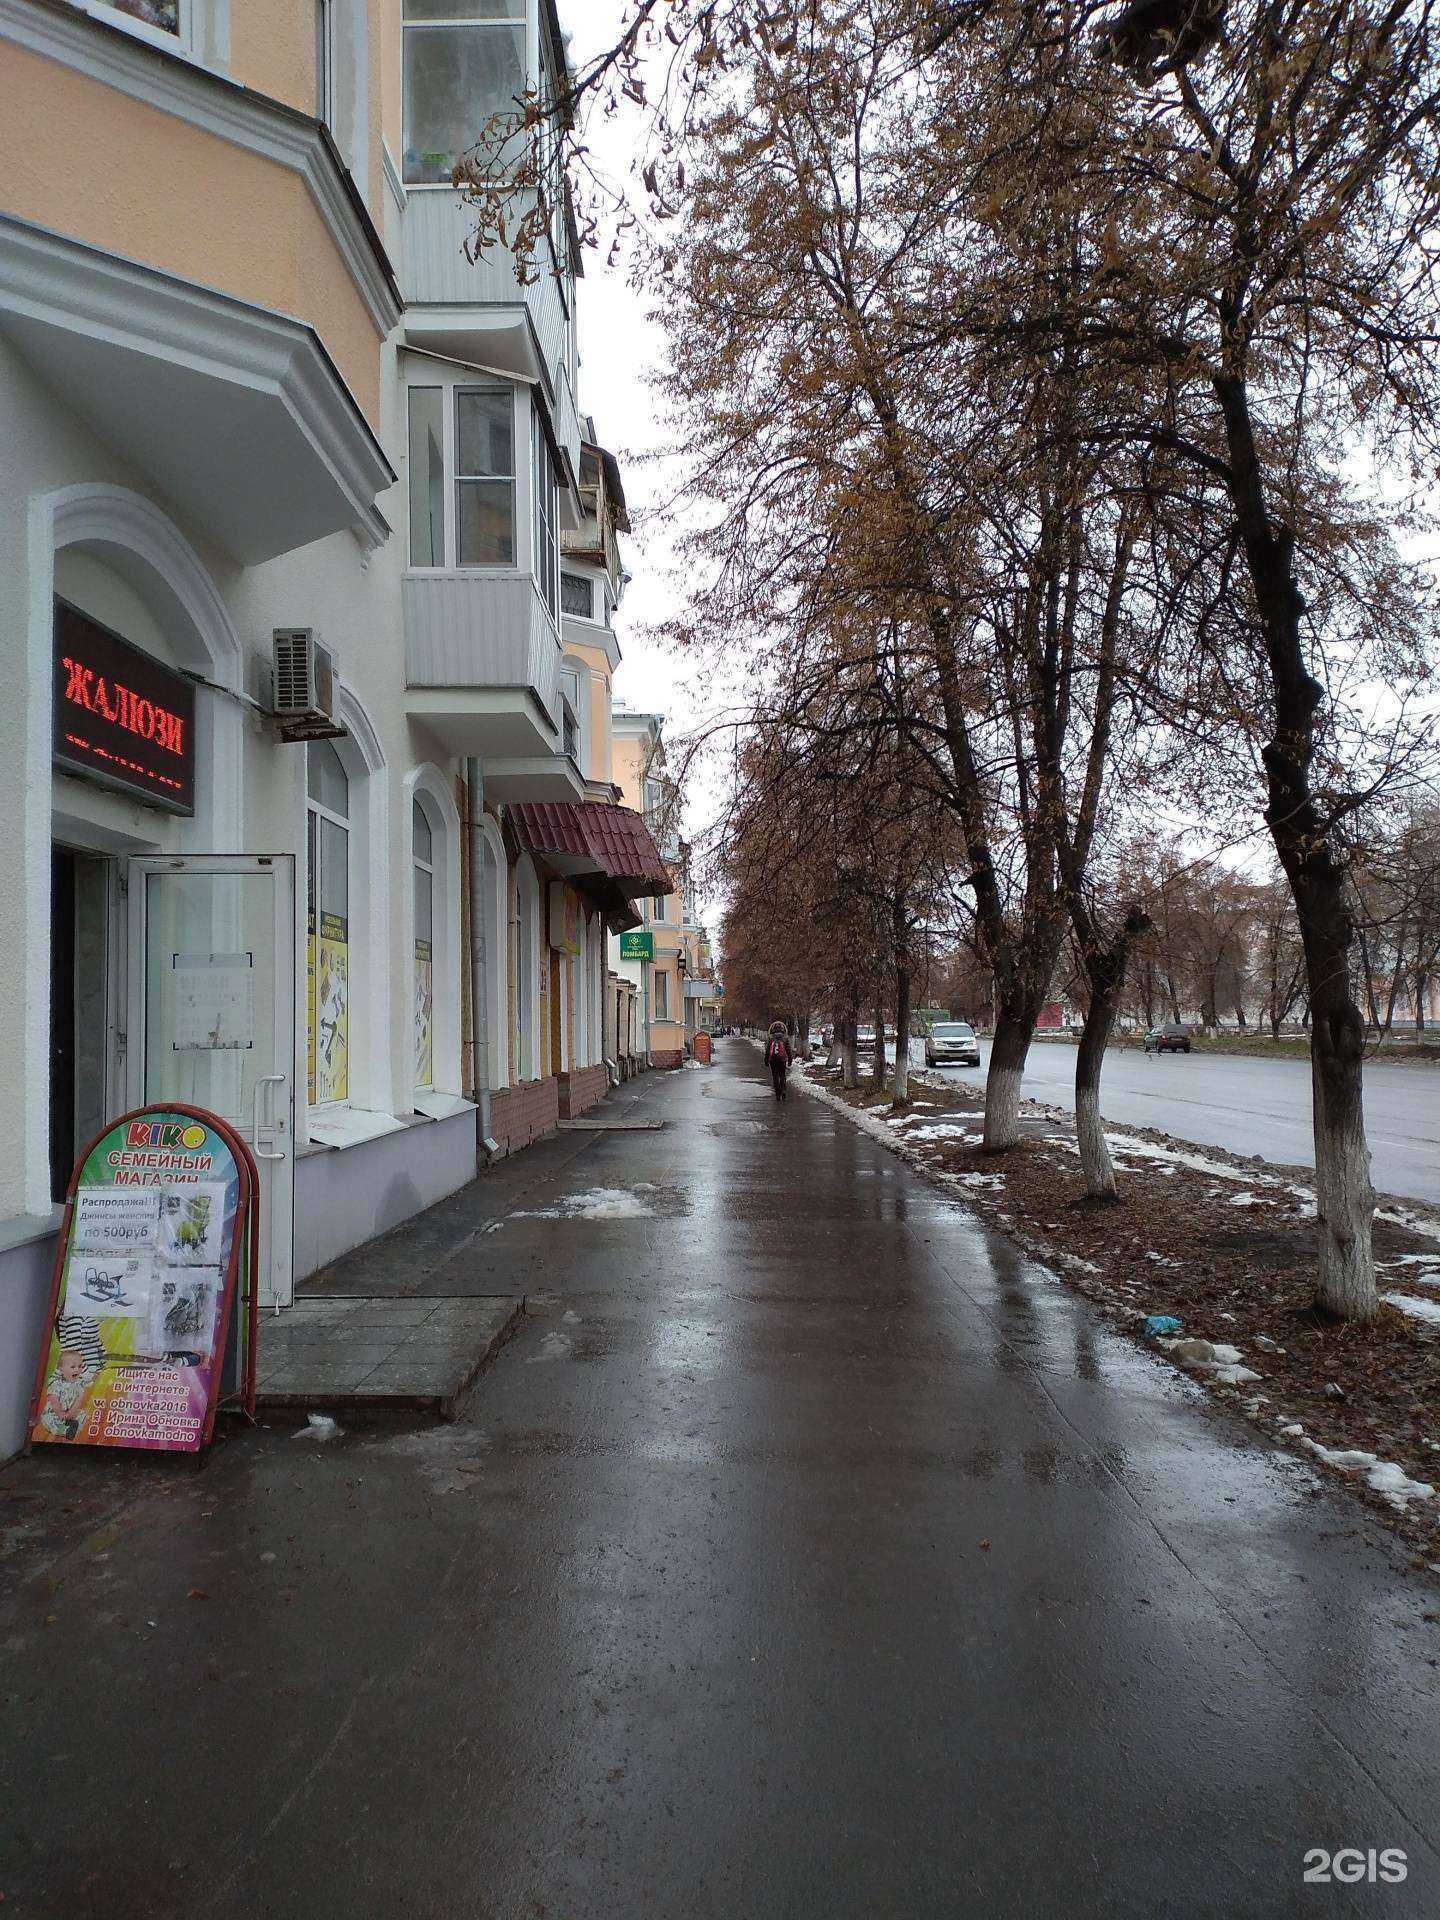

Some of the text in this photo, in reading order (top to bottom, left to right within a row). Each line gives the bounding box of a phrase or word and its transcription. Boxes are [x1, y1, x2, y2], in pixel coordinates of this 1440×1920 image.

[62, 656, 184, 755] ЖАЛЮЗИ
[126, 1121, 206, 1150] KIKO
[108, 1150, 213, 1171] СЕМЕЙНЫЙ
[85, 1225, 149, 1239] по 500руб
[117, 1368, 179, 1381] Ищите нас
[114, 1383, 189, 1396] в интернете:
[110, 1398, 188, 1412] obnovka2016
[107, 1411, 200, 1427] Ирина Обновка
[105, 1425, 195, 1442] obnovkamodno
